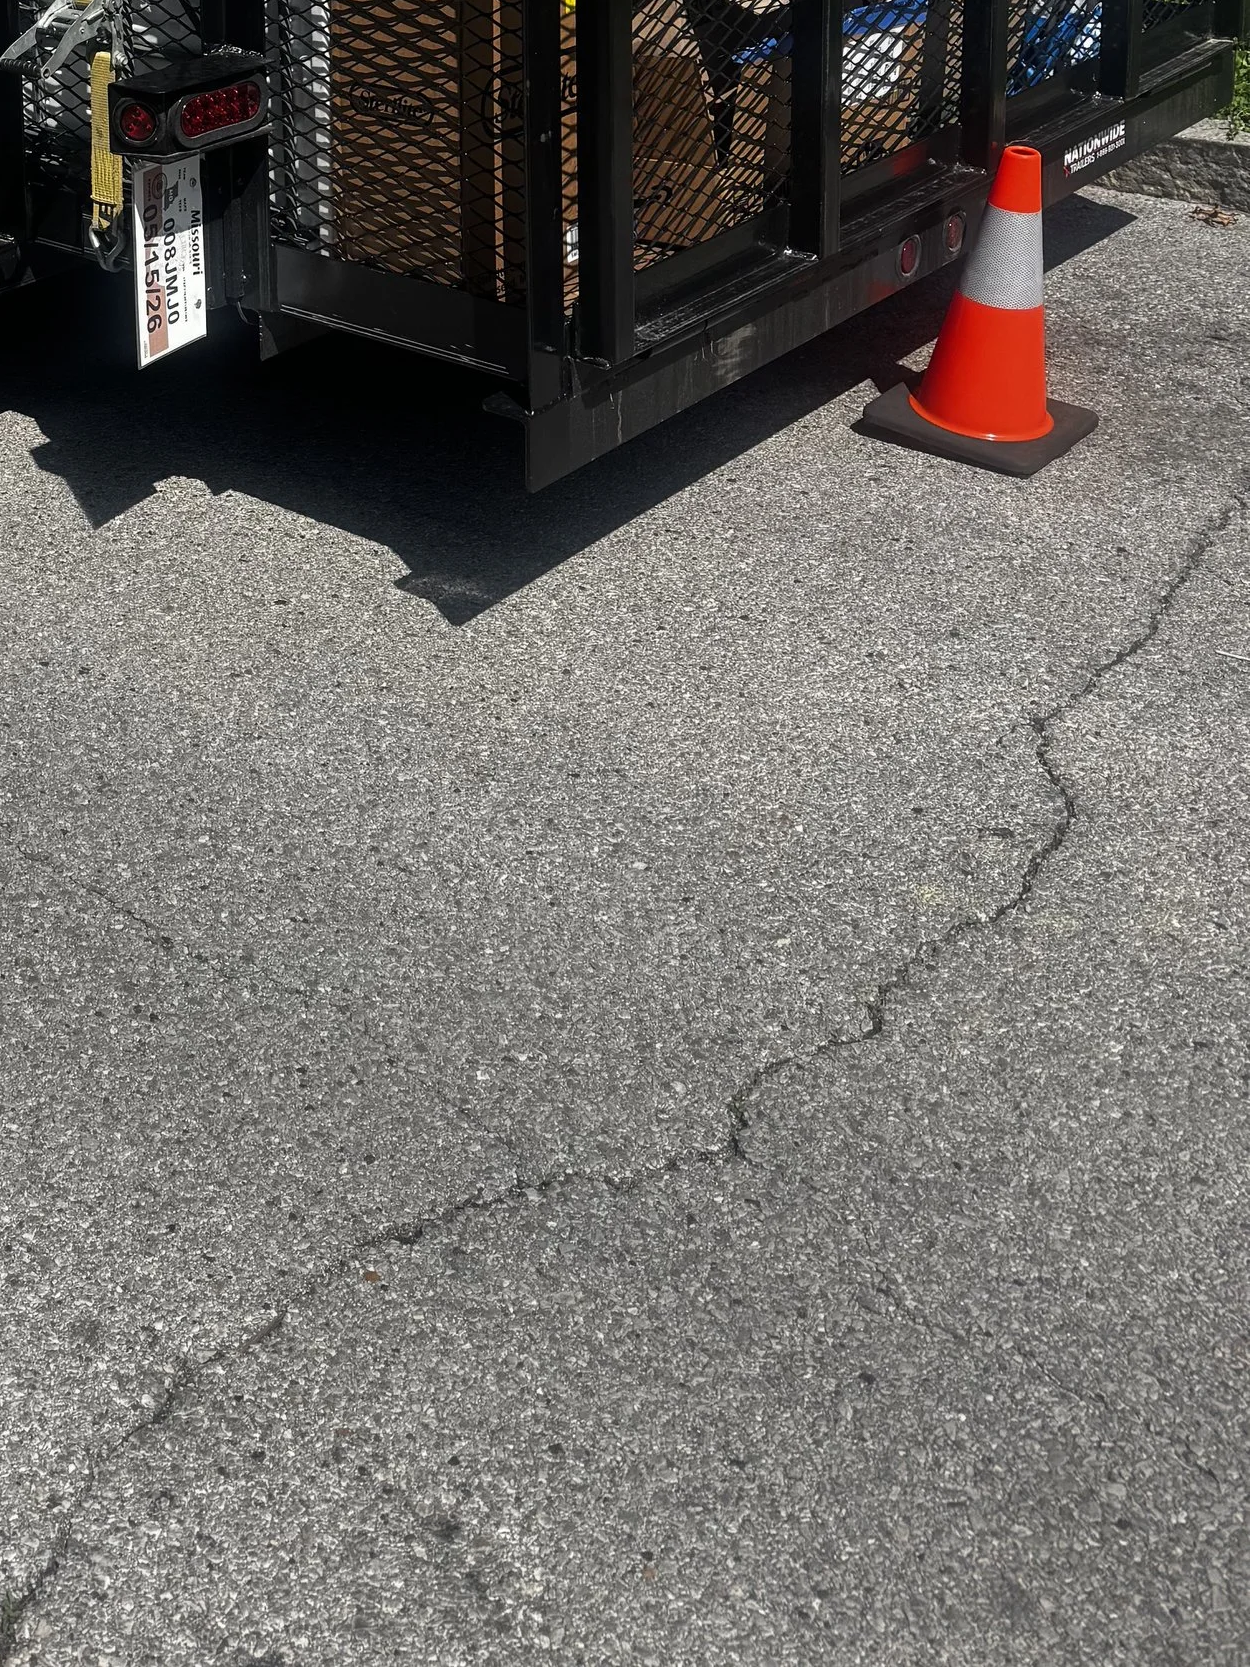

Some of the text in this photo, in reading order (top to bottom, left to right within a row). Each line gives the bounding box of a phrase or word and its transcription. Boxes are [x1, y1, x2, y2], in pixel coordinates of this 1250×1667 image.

[1070, 152, 1096, 174] TRAILERS
[143, 204, 162, 334] 05/15/26
[190, 209, 204, 276] Missouri
